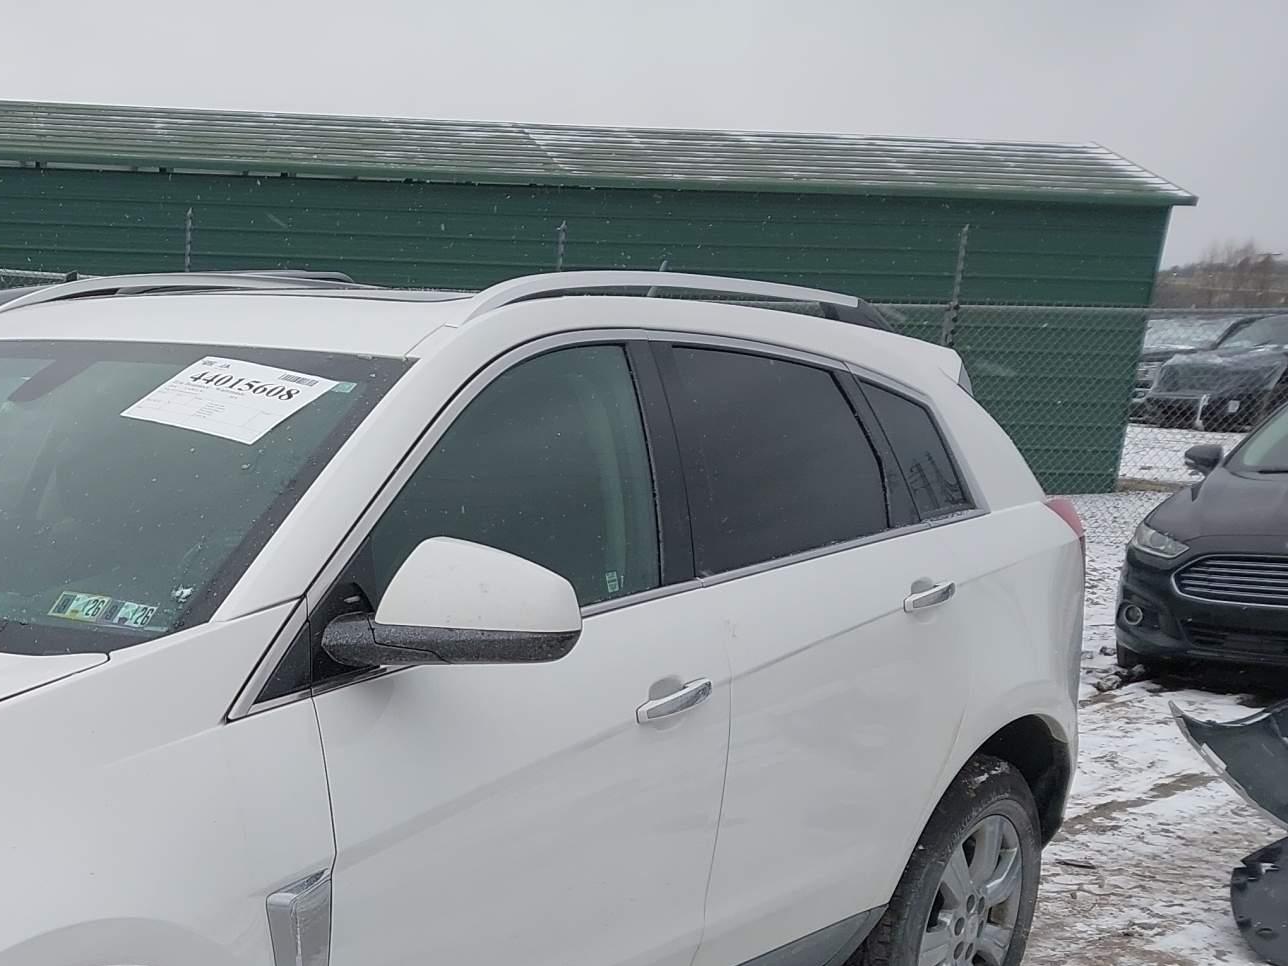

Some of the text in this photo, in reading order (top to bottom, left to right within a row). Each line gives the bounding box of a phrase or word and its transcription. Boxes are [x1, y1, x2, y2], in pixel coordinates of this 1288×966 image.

[189, 370, 302, 401] 44015608
[85, 598, 106, 617] 26
[134, 606, 155, 626] 26
